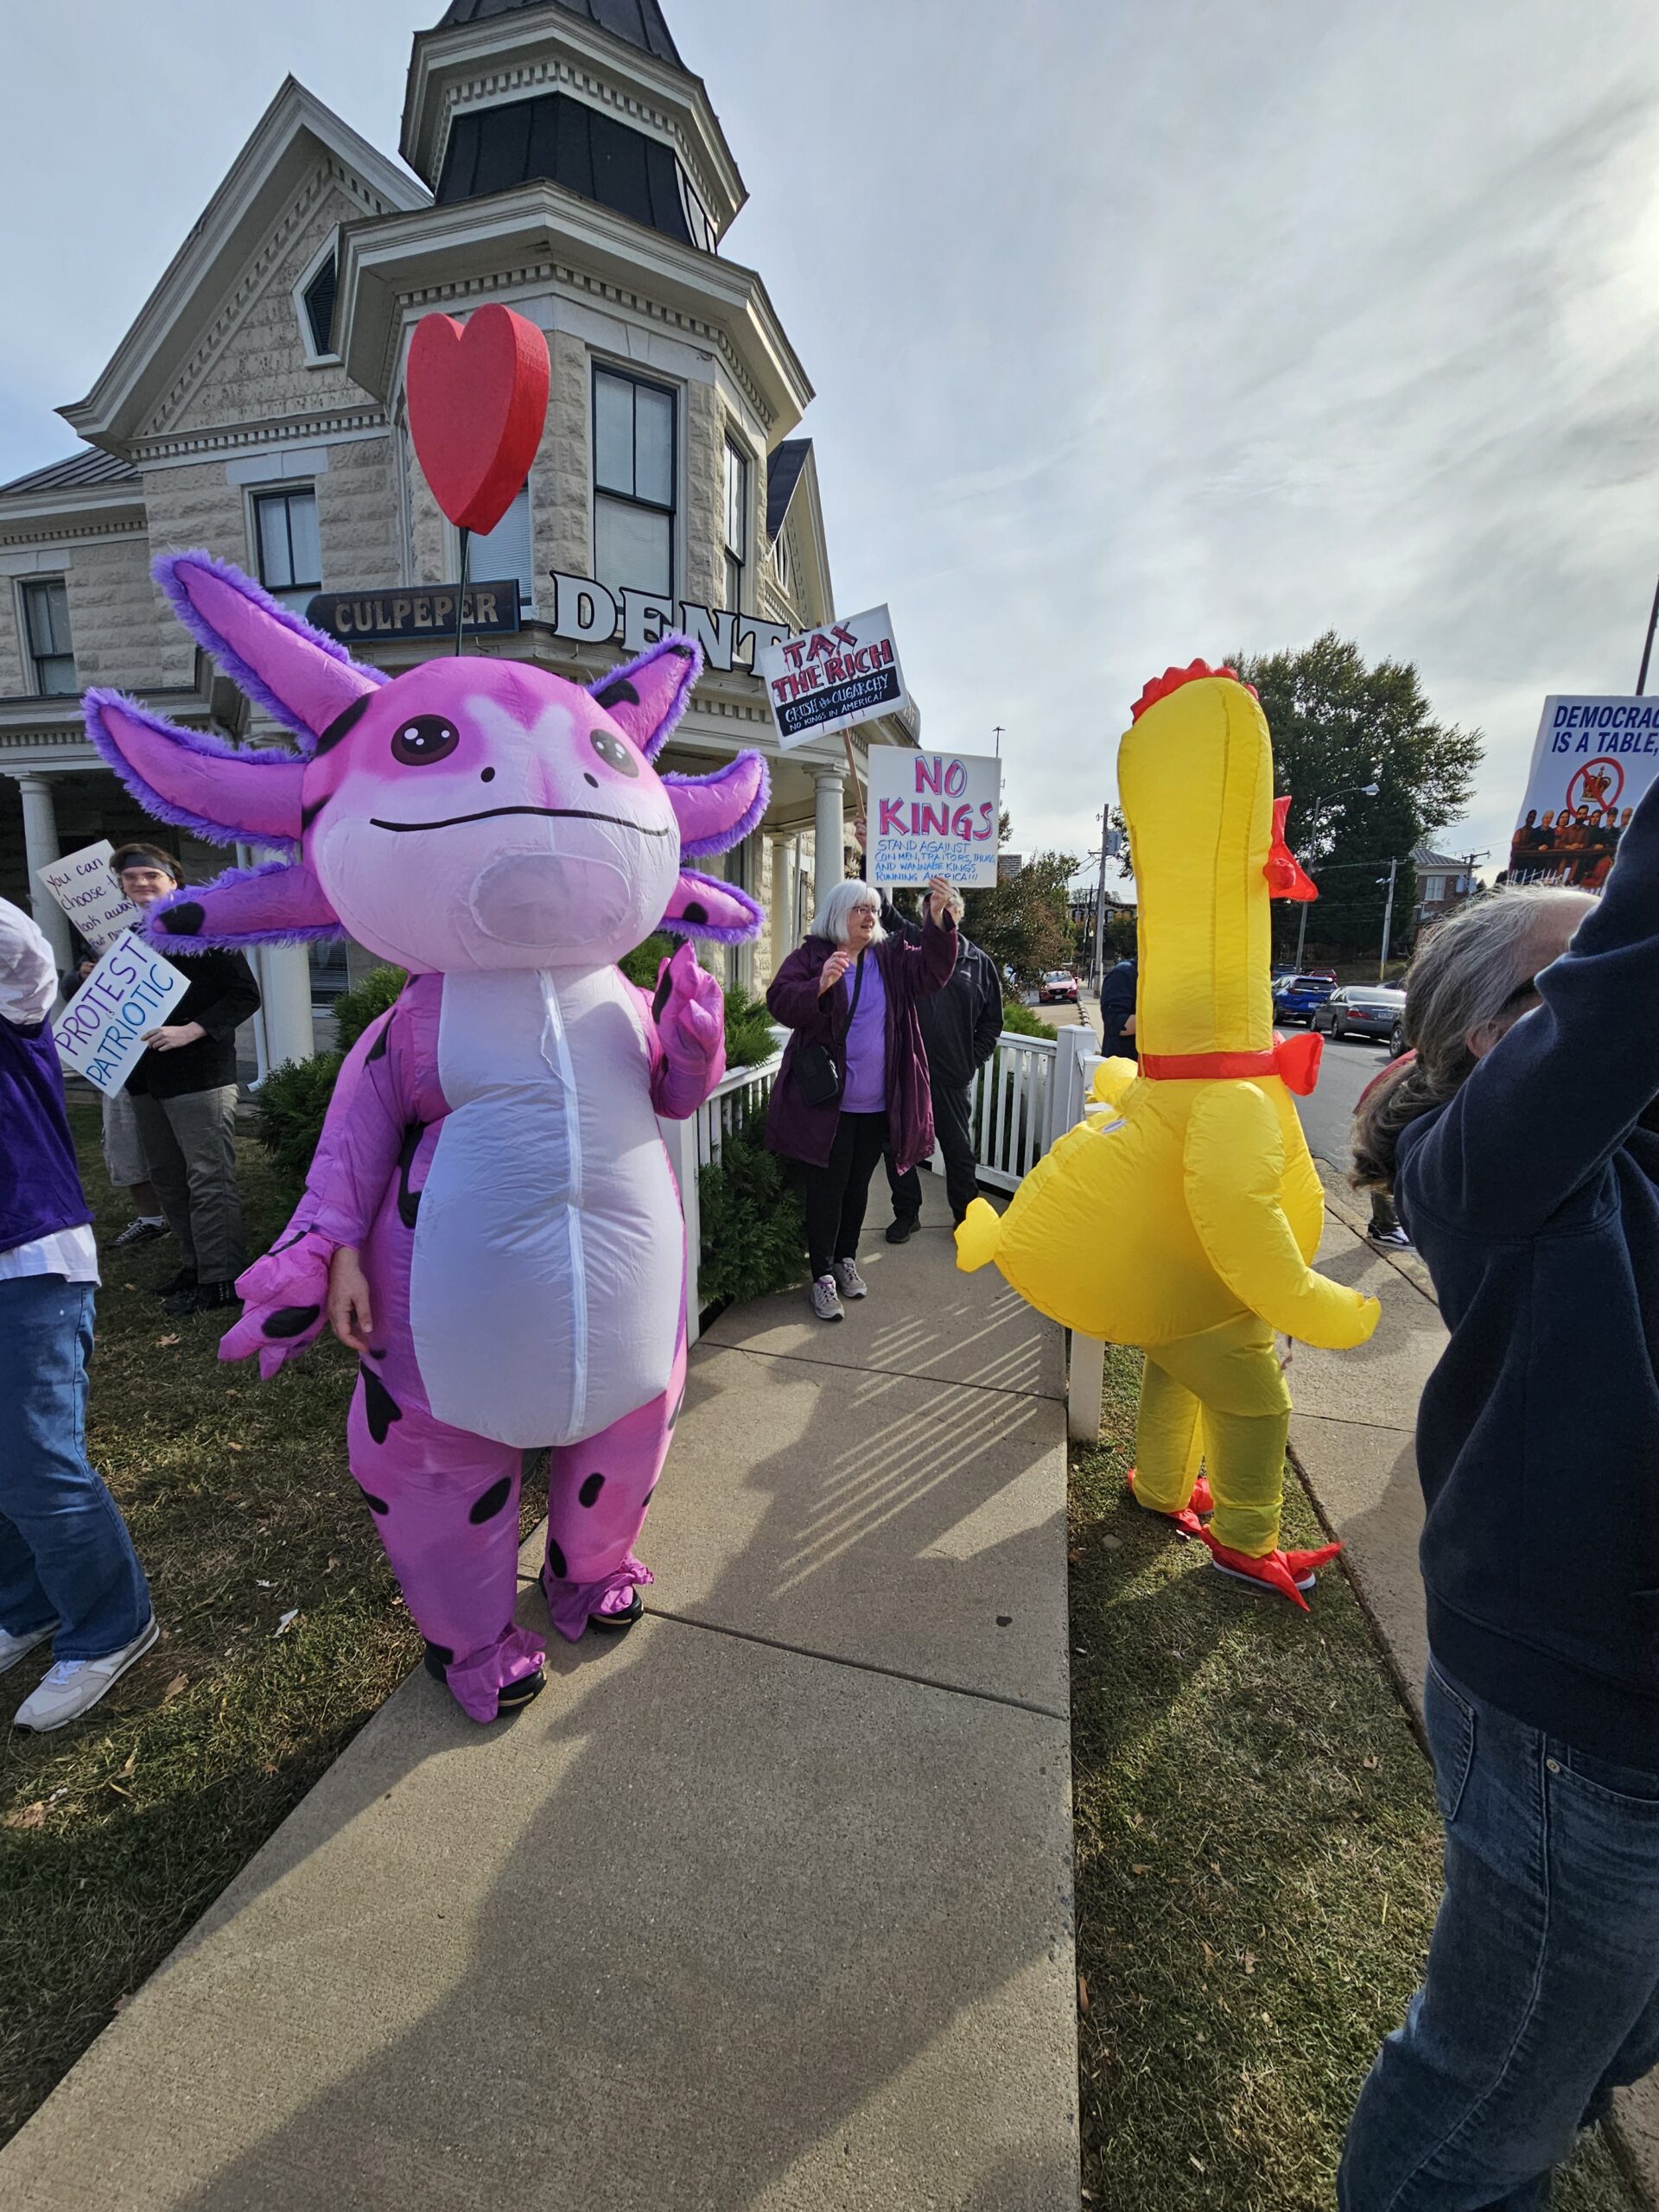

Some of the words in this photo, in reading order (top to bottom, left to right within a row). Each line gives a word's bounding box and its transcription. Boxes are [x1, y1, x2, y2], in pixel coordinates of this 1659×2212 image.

[334, 592, 499, 633] CULPEPER
[549, 569, 809, 677] DENT
[782, 621, 858, 669] TAX
[772, 664, 825, 700] THE
[824, 639, 894, 685] RICH
[785, 698, 819, 723] CRUSH
[832, 673, 888, 704] OLIGARCHY
[789, 721, 802, 731] NO
[804, 712, 827, 727] KINGS
[830, 709, 838, 717] IN
[842, 691, 882, 714] AMERICA!
[1552, 731, 1572, 753] IS
[1575, 732, 1589, 753] A
[1598, 732, 1658, 756] TABLE,
[915, 755, 968, 798] NO
[880, 797, 994, 842] KINGS
[76, 858, 104, 875] can
[874, 852, 896, 862] CON
[921, 853, 972, 864] TRAITORS,
[877, 839, 917, 852] STAND
[919, 840, 971, 853] AGAINST
[875, 862, 896, 871] AND
[946, 862, 976, 873] KINGS
[74, 915, 101, 933] look
[104, 900, 138, 920] away
[54, 937, 148, 1057] PROTEST
[86, 963, 174, 1086] PATRIOTIC
